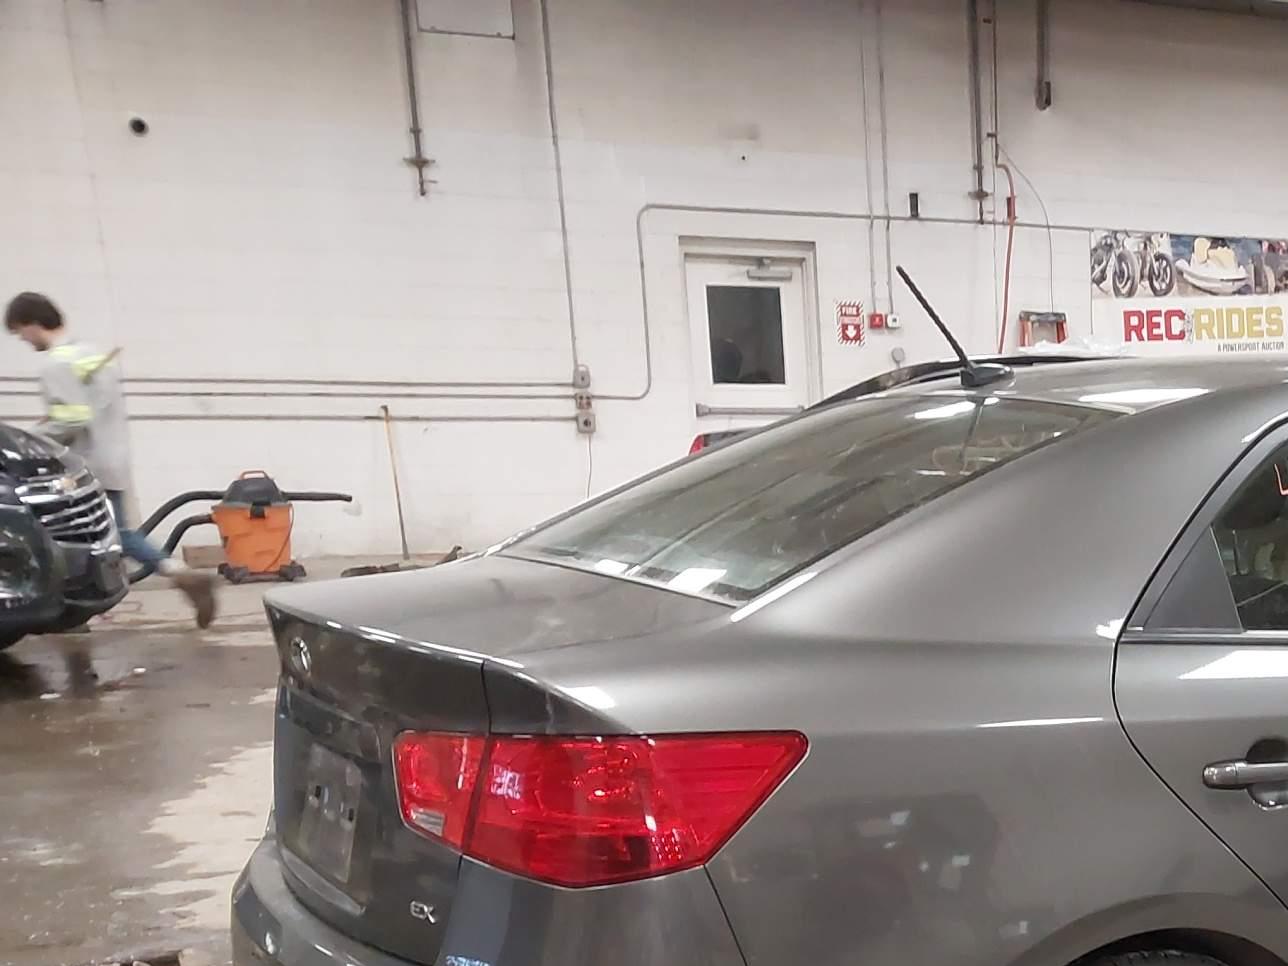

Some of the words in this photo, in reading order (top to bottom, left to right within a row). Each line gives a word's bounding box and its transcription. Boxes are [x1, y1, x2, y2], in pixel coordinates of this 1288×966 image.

[1123, 309, 1186, 342] REC
[1194, 306, 1284, 340] RIDES
[1261, 341, 1285, 351] AUCTION
[410, 901, 436, 923] EX
